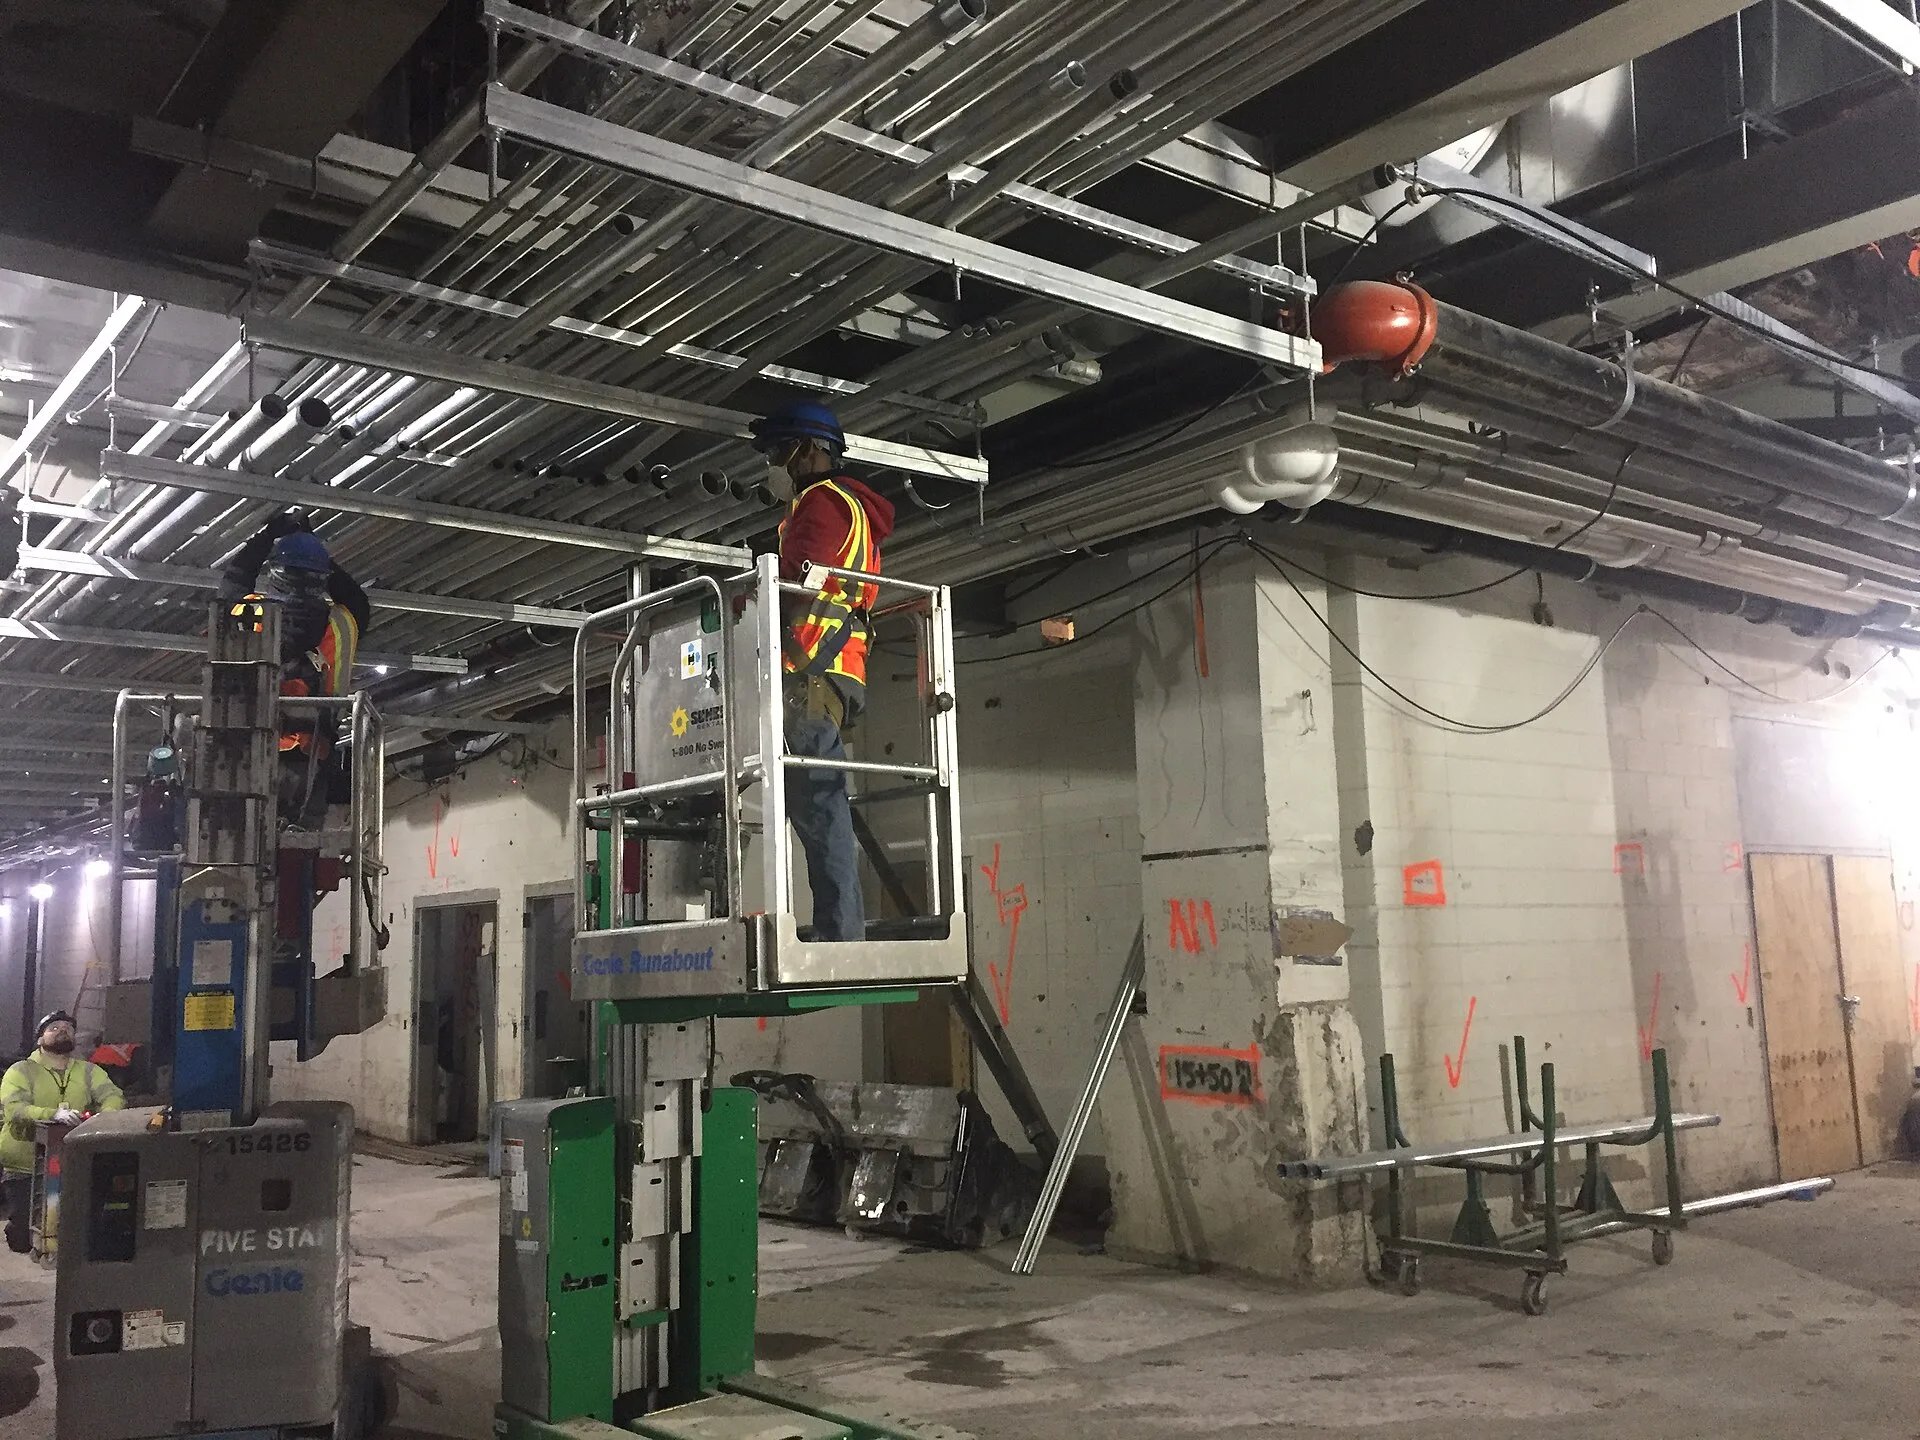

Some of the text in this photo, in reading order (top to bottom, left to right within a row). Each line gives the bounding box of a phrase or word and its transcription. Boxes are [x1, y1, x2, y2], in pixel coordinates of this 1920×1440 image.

[671, 744, 694, 757] 1-800
[695, 742, 707, 753] No
[629, 946, 714, 973] Runabout
[225, 1132, 312, 1155] 15426
[201, 1228, 257, 1255] FIVE
[204, 1265, 304, 1297] Genie
